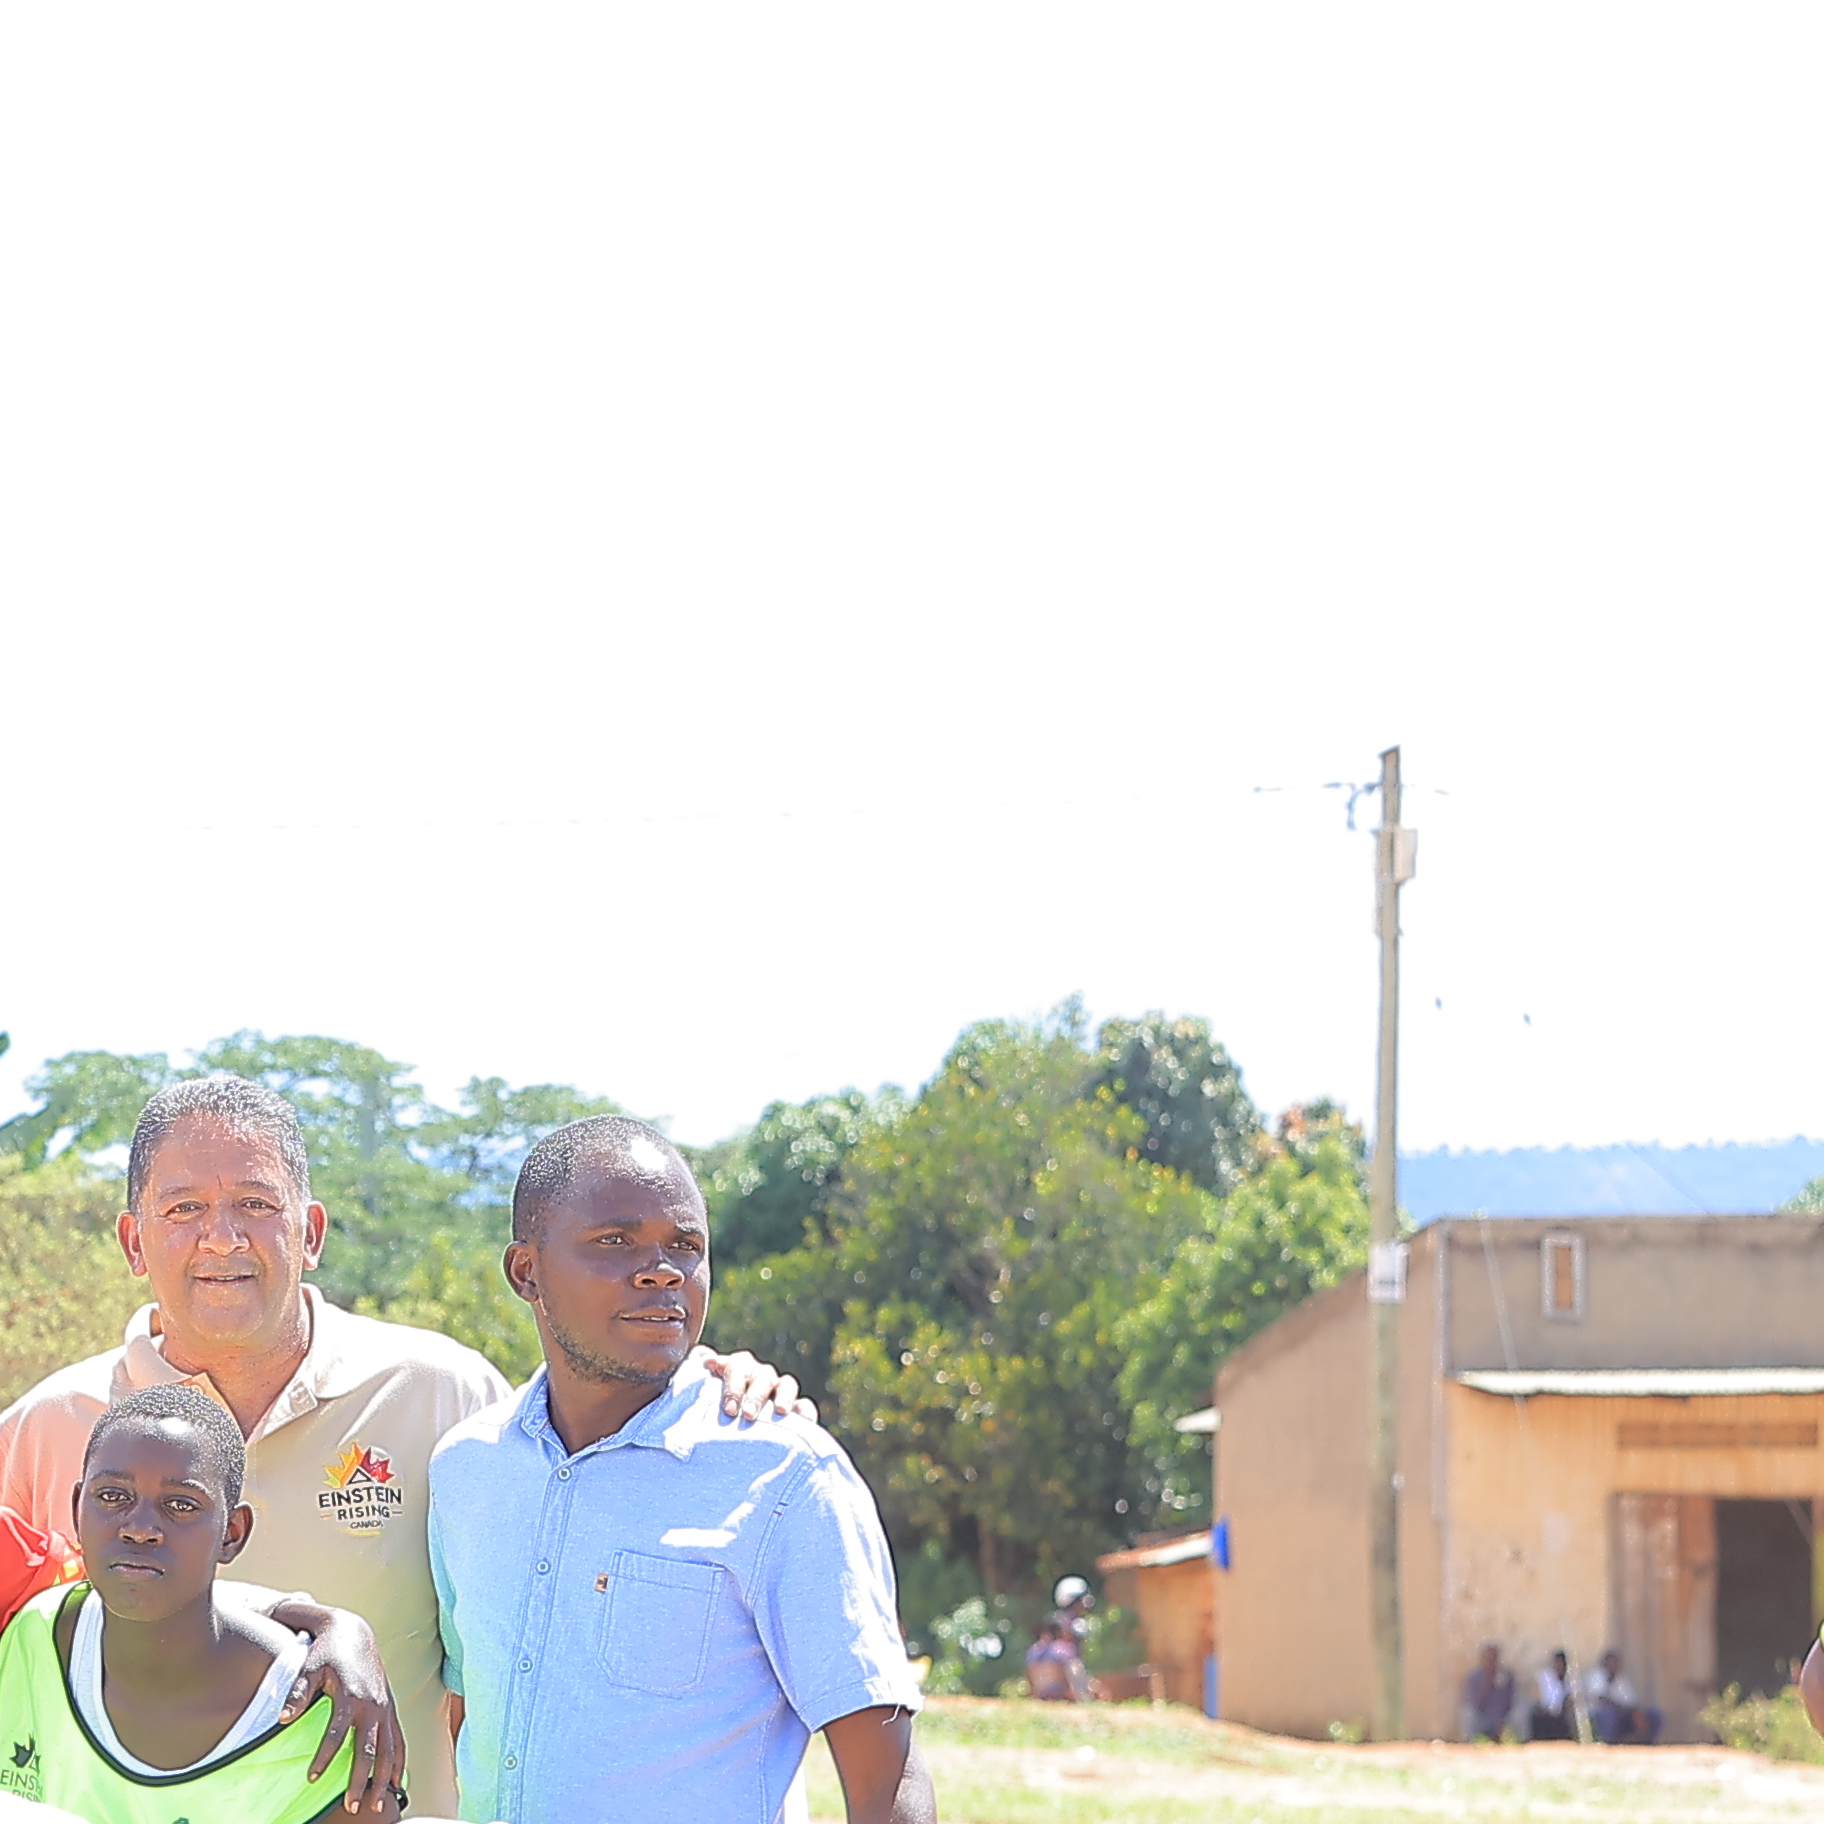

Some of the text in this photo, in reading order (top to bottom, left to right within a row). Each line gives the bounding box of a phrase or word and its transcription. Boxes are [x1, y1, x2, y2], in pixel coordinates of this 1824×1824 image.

[318, 1486, 402, 1508] EINSTEIN
[337, 1505, 390, 1520] RISING
[350, 1520, 384, 1530] CANADA
